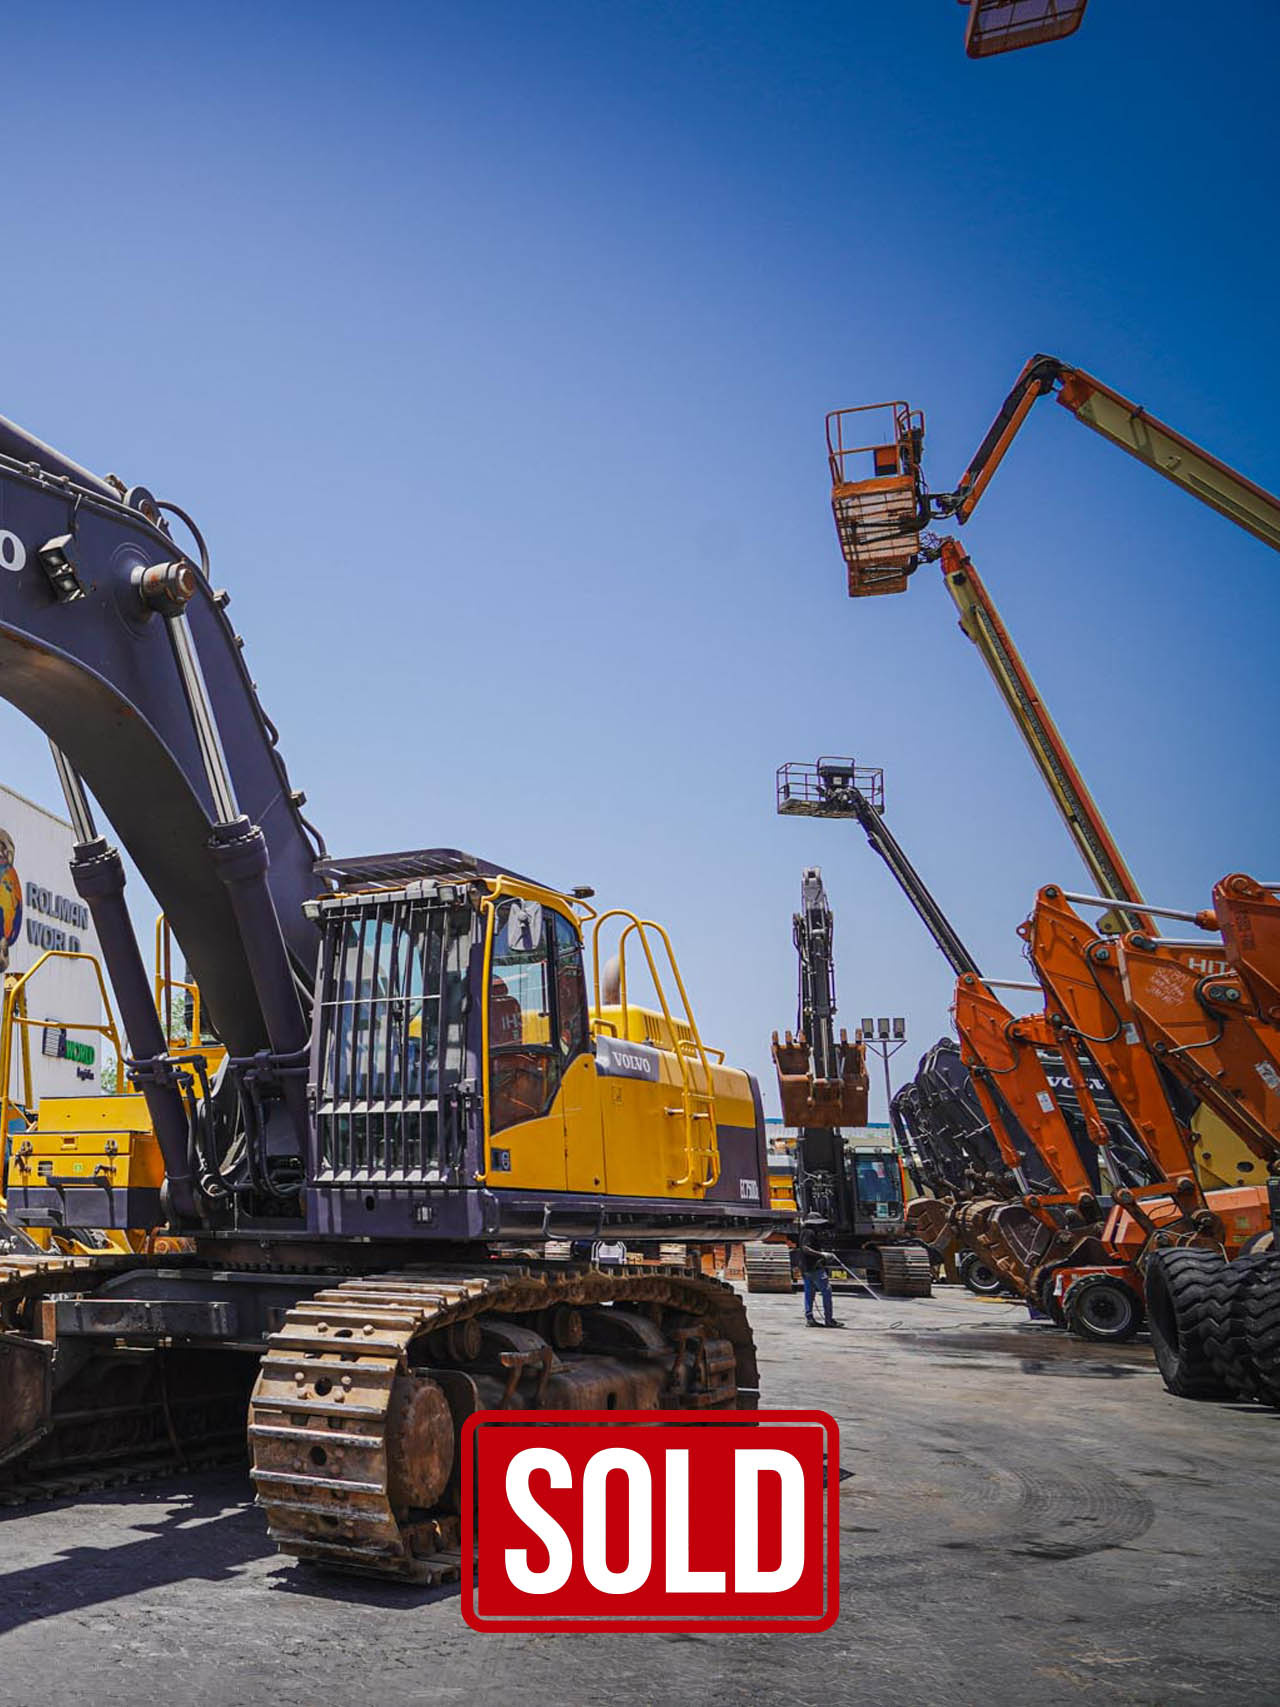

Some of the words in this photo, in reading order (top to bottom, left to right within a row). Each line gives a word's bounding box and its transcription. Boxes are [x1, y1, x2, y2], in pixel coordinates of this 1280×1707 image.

[26, 882, 89, 930] ROLMAN
[26, 918, 81, 960] WORLD
[612, 1051, 651, 1073] VOLVO
